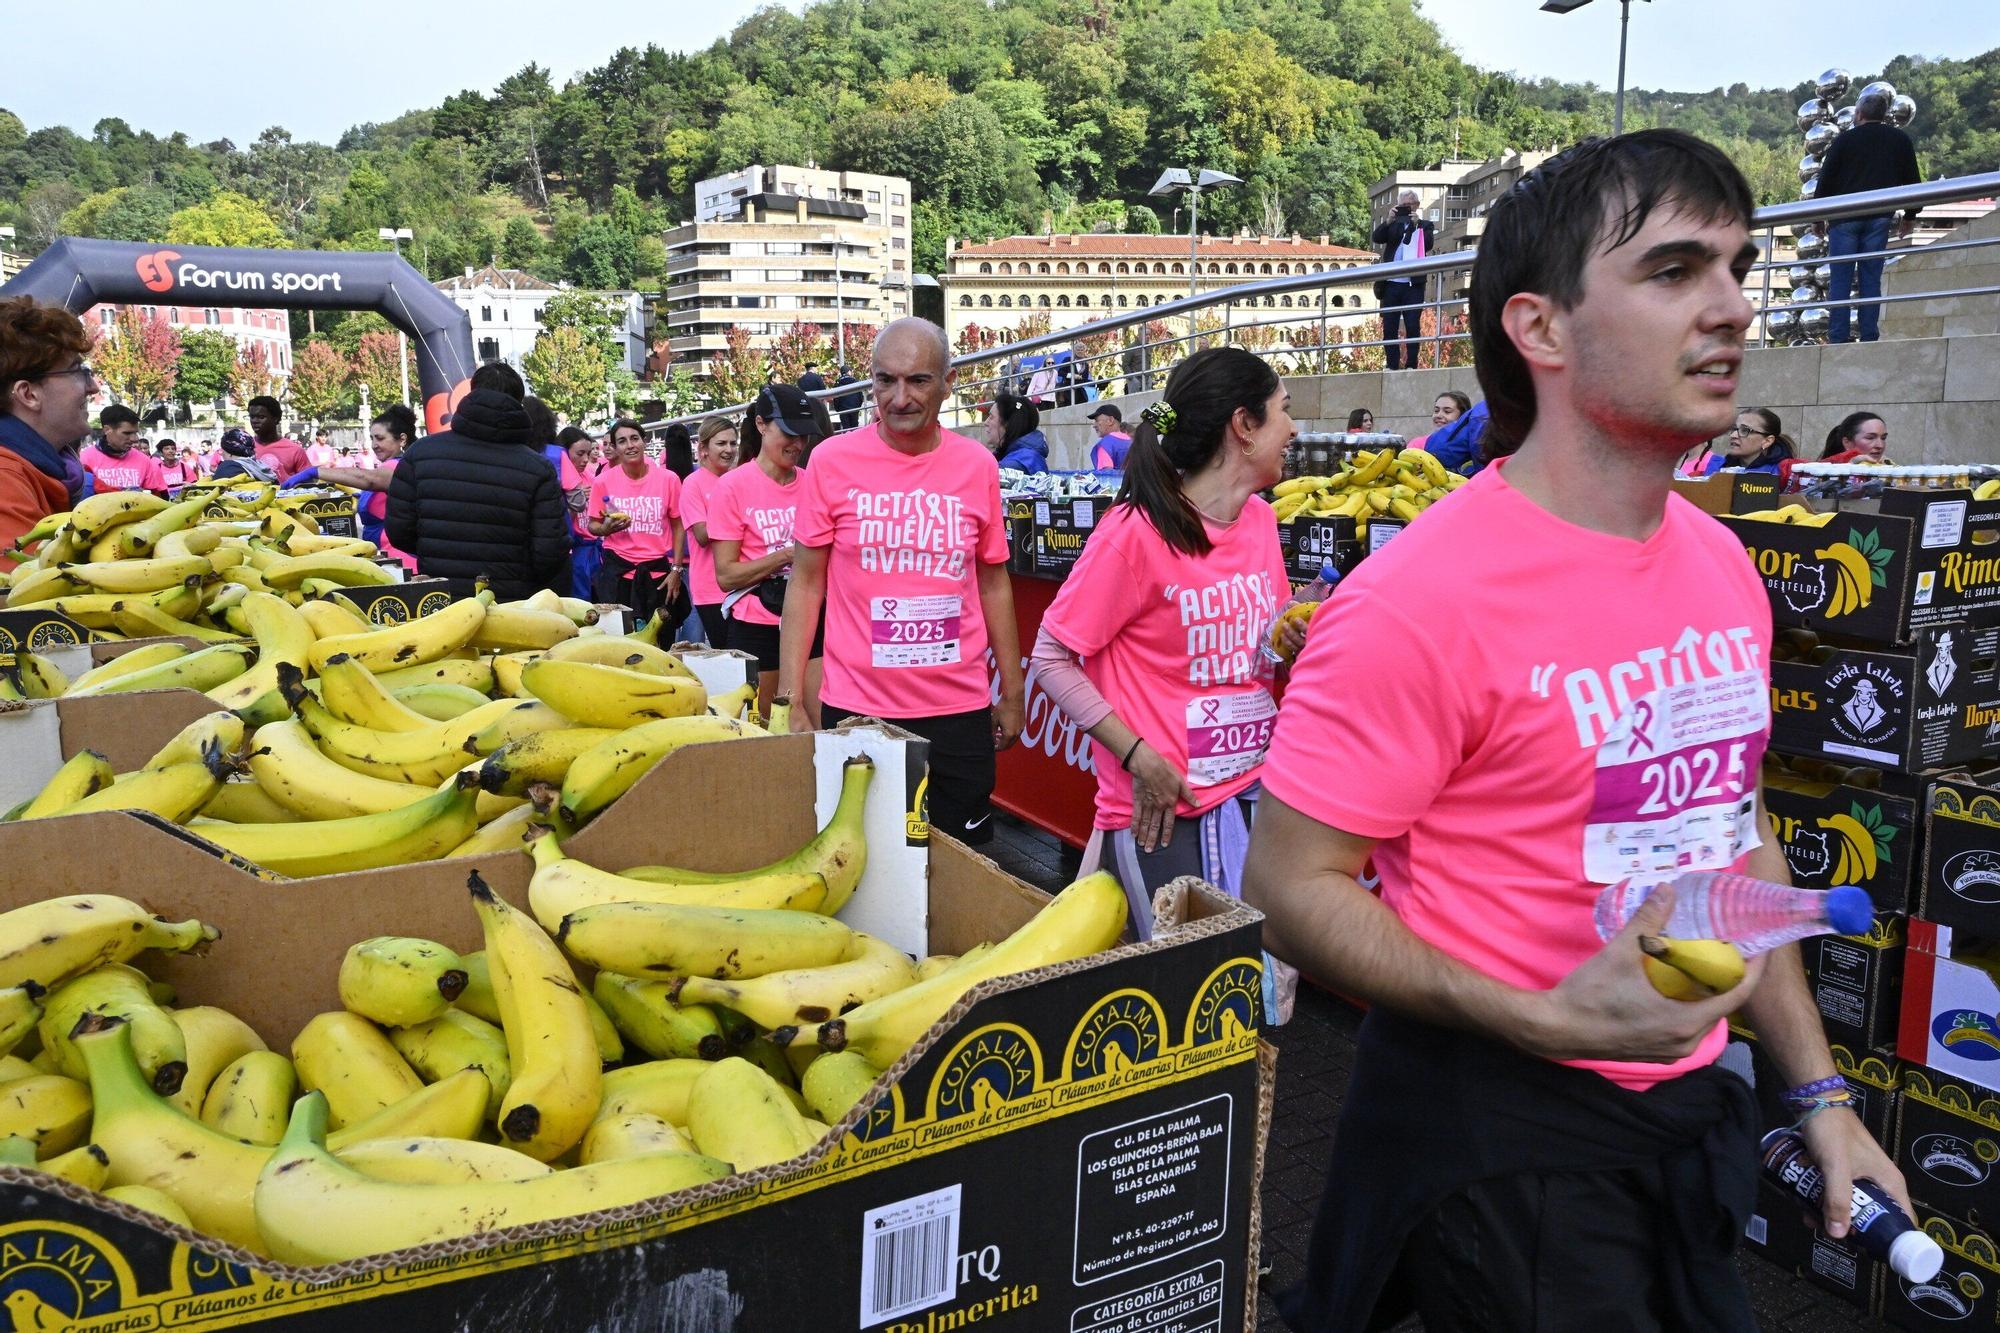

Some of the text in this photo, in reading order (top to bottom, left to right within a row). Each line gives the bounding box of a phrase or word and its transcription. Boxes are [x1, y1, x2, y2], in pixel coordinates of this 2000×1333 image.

[271, 272, 342, 294] sport
[1740, 483, 1774, 495] Rimor
[1044, 527, 1082, 551] Rimor
[861, 546, 967, 581] AVANZA
[1787, 581, 1818, 595] TELDE
[889, 620, 945, 642] 2025
[1825, 661, 1904, 699] Costa Caleta
[1917, 702, 1958, 720] Costa Caleta
[1210, 720, 1271, 753] 2025
[1867, 726, 1898, 744] Canarias
[1636, 742, 1747, 815] 2025
[1789, 845, 1822, 862] TELDE
[1196, 967, 1262, 1034] COPALM
[1075, 1000, 1157, 1069] COPALMA
[940, 1034, 1032, 1106] COPALMA
[1181, 1043, 1222, 1067] Plátanos
[1224, 1039, 1236, 1052] de
[1058, 1060, 1172, 1102] Plátanos de Canarias
[921, 1096, 1048, 1143] Plátanos de Canarias
[1114, 1114, 1201, 1149] C.U. DE LA PALMA
[832, 1154, 849, 1170] de
[852, 1136, 910, 1164] Canarias
[1087, 1123, 1224, 1175] LOS GUINCHOS-BREÑA BAJA
[1112, 1145, 1201, 1181] ISLA DE LA PALMA
[1114, 1160, 1197, 1195] ISLAS CANARIAS
[1135, 1183, 1176, 1204] ESPAÑA
[1125, 1227, 1144, 1242] R.S.
[1145, 1210, 1195, 1235] 40-2297-TF
[1856, 1201, 1888, 1229] Kaiku
[474, 1243, 495, 1259] de
[1082, 1218, 1219, 1273] Número de Registro IGP A-063
[172, 1292, 257, 1321] Plátanos
[262, 1283, 285, 1303] de
[1093, 1272, 1205, 1322] CATEGORÍA EXTRA
[1127, 1316, 1142, 1330] de
[1145, 1297, 1195, 1324] Canarias
[1198, 1286, 1218, 1305] IGP
